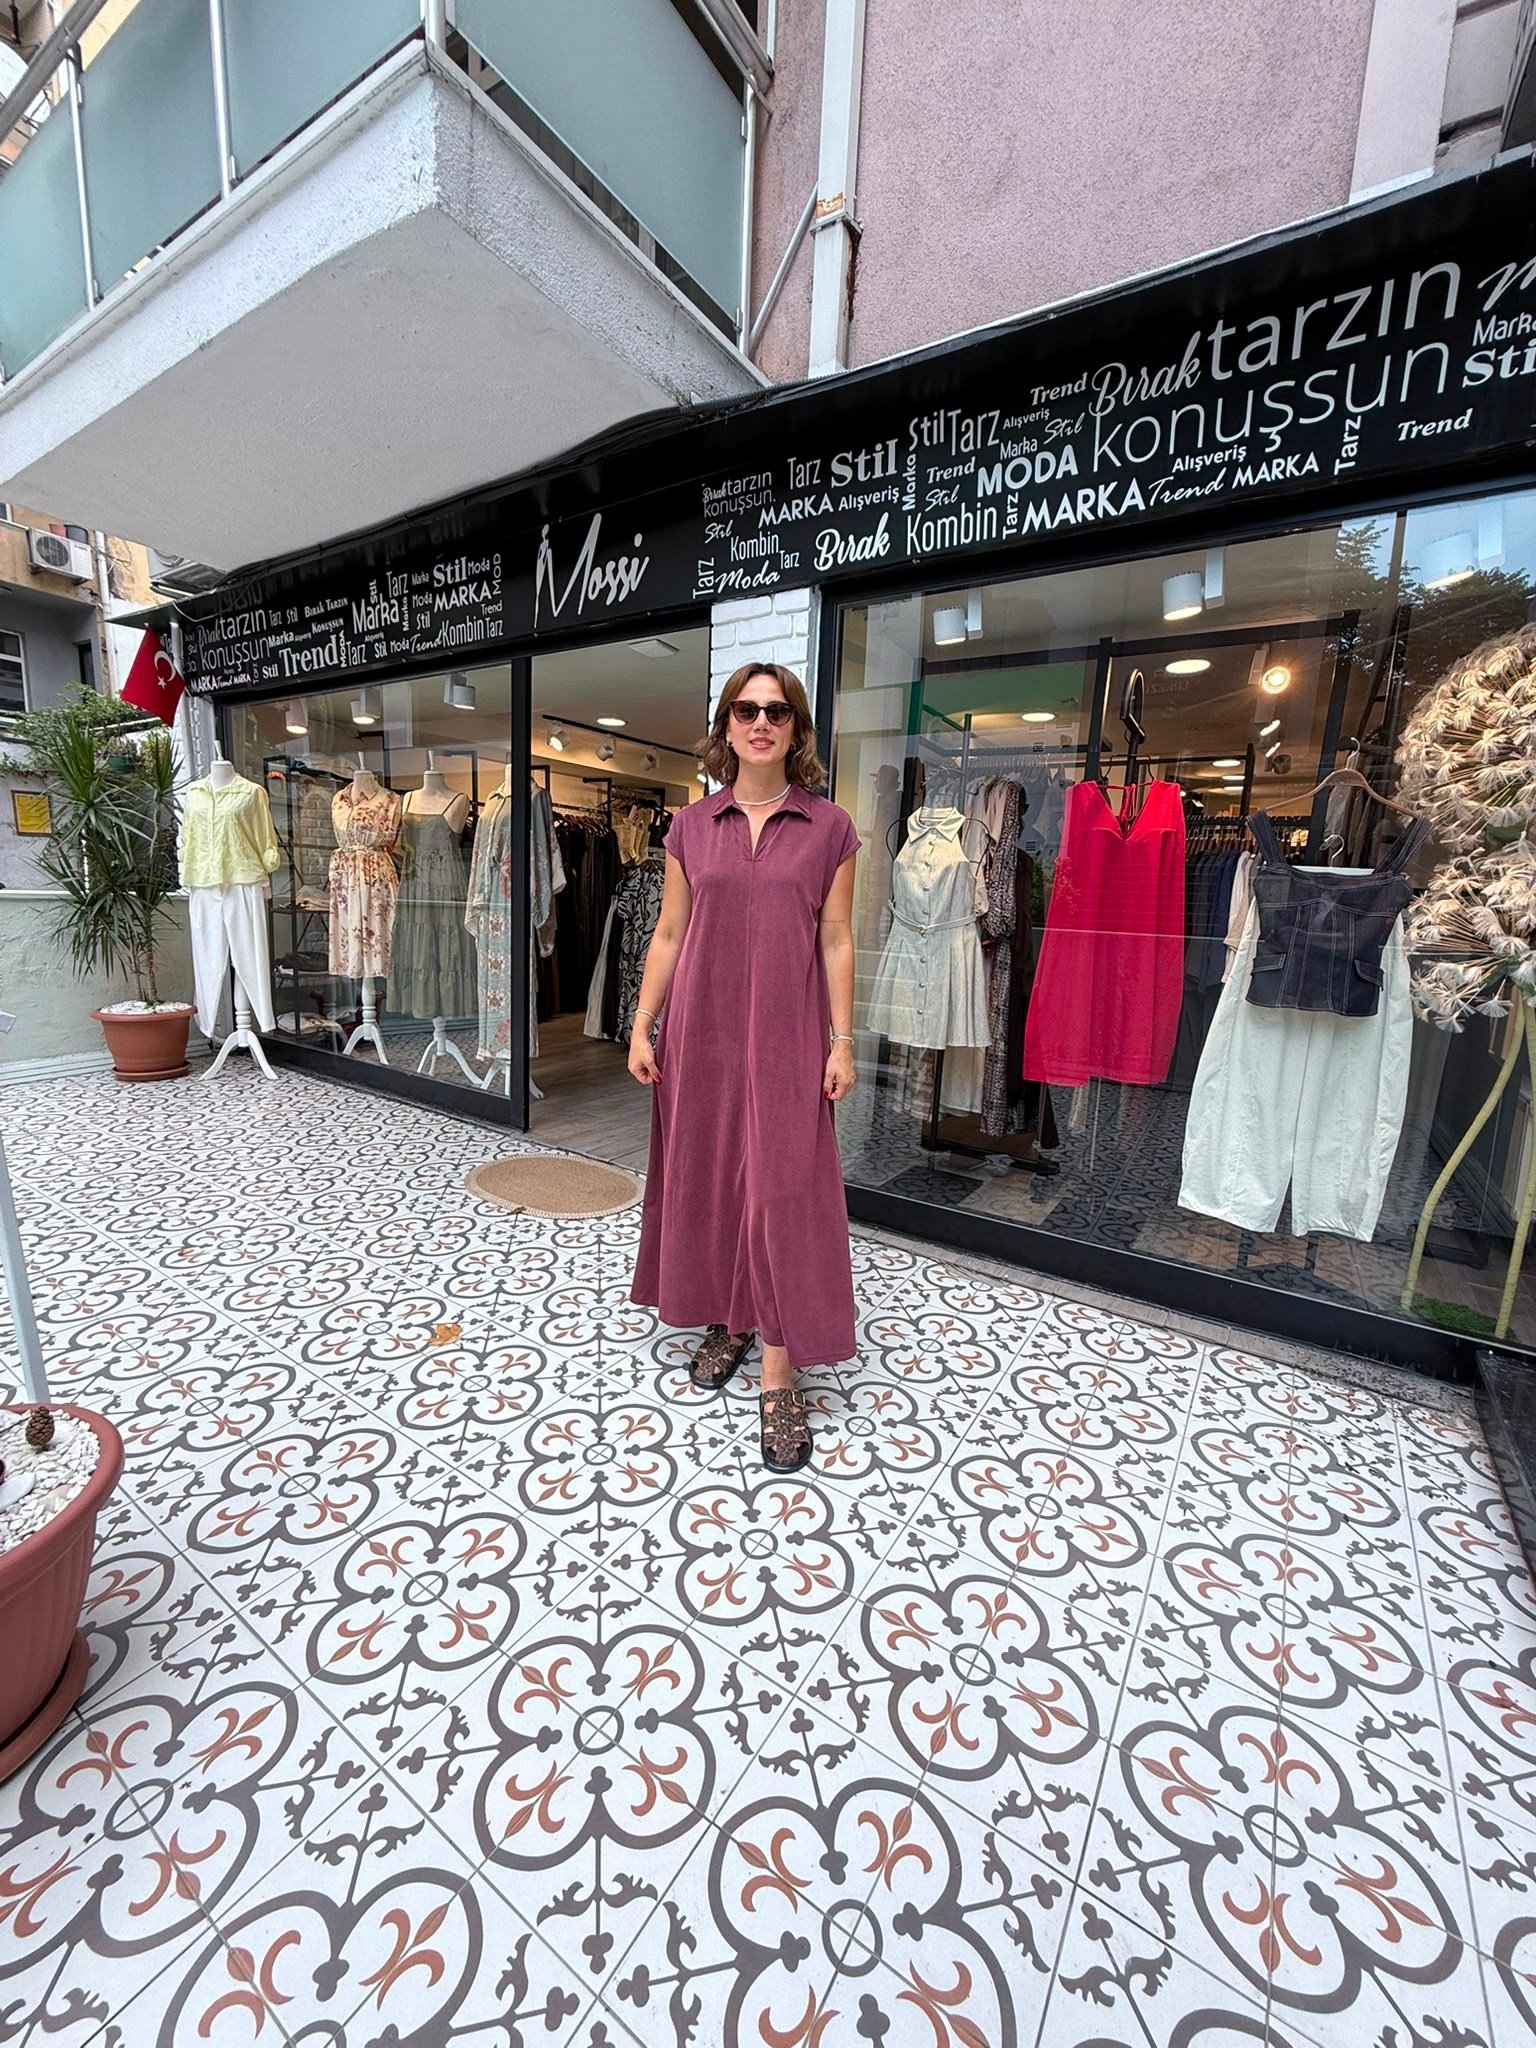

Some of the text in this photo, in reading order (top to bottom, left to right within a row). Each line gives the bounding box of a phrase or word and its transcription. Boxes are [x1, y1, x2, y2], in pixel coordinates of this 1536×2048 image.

[1089, 330, 1202, 417] Bırak
[1207, 261, 1463, 380] tarzın
[1030, 372, 1087, 406] Trend
[1003, 407, 1050, 430] Alışveriş
[1092, 340, 1449, 472] konuşsun
[908, 408, 1000, 456] Stil Tarz
[1044, 413, 1084, 445] Stil
[1397, 408, 1474, 442] Trend
[1000, 438, 1038, 460] Marka
[1172, 444, 1248, 473] Alışveriş
[1333, 415, 1362, 476] Tarz
[787, 457, 821, 491] Tarz
[830, 438, 899, 489] Stil
[926, 457, 976, 485] Trend
[977, 444, 1079, 498] MODA
[726, 471, 772, 495] tarzın
[902, 453, 917, 511] Marka
[926, 484, 960, 512] Stil
[1021, 451, 1320, 535] MARKA Trend MARKA
[758, 487, 900, 528] MARKA Alışveriş
[1002, 491, 1019, 540] Tarz
[704, 518, 734, 544] Stil
[813, 511, 892, 572] Bırak
[906, 502, 997, 556] Kombin
[730, 532, 800, 570] Kombin Tarz
[386, 571, 409, 598] Tarz
[433, 556, 490, 588] Stil Moda
[534, 513, 650, 629] Mossi
[692, 556, 715, 599] Tarz
[715, 560, 781, 594] Moda
[352, 592, 400, 634] Marka
[412, 591, 433, 608] Moda
[434, 580, 492, 613] MARKA
[481, 599, 503, 616] Trend
[220, 609, 267, 640] tarzın
[269, 606, 299, 627] Tarz Stil
[417, 610, 431, 631] Stil
[442, 615, 504, 648] Kombin Tarz
[201, 637, 270, 672] konuşsun
[268, 630, 294, 648] Marka
[278, 634, 339, 677] Trend
[346, 641, 367, 667] Tarz
[374, 637, 410, 658] Stil Moda
[410, 629, 443, 654] Trend
[190, 675, 219, 693] MARKA
[262, 663, 279, 679] Stil
